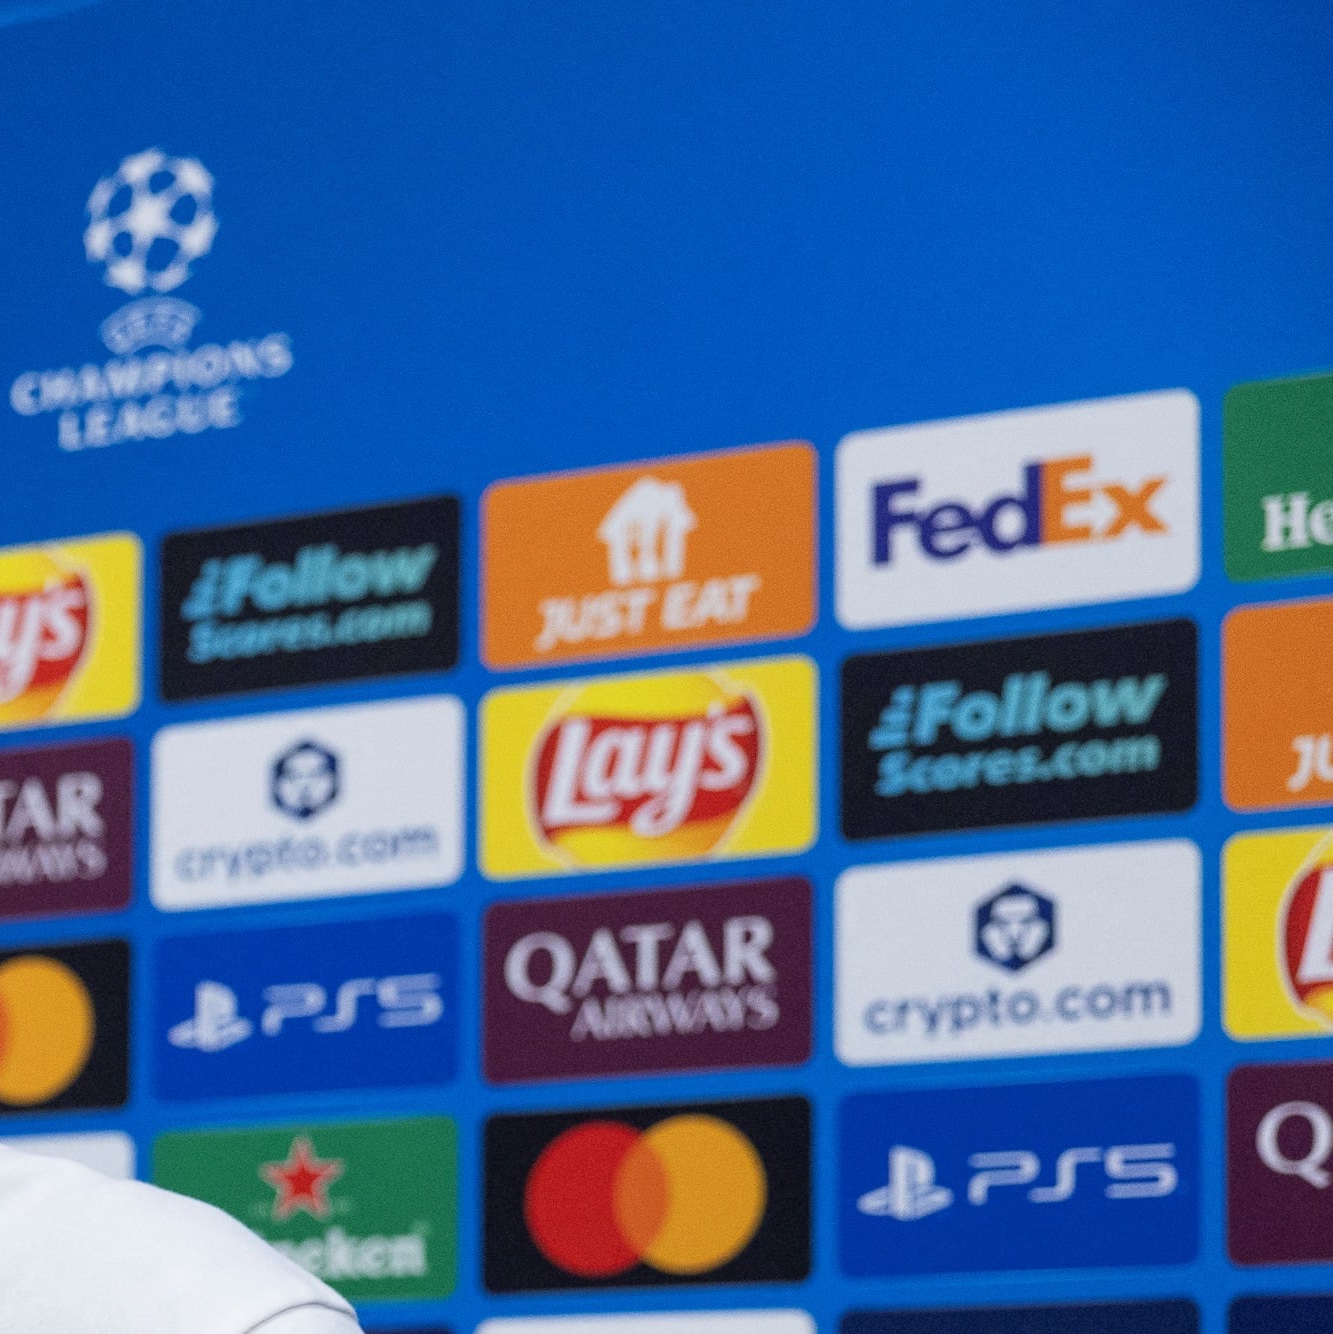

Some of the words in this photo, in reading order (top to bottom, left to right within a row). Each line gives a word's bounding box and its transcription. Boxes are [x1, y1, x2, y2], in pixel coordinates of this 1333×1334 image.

[870, 454, 1169, 568] FedEx
[536, 588, 655, 651] JUST
[661, 574, 761, 628] EAT
[542, 702, 757, 836] Lay's
[875, 734, 1162, 797] Scores.com
[504, 915, 776, 1015] QATAR
[262, 972, 444, 1037] PS5
[863, 976, 1173, 1038] crypto.com
[969, 1143, 1179, 1205] PS5
